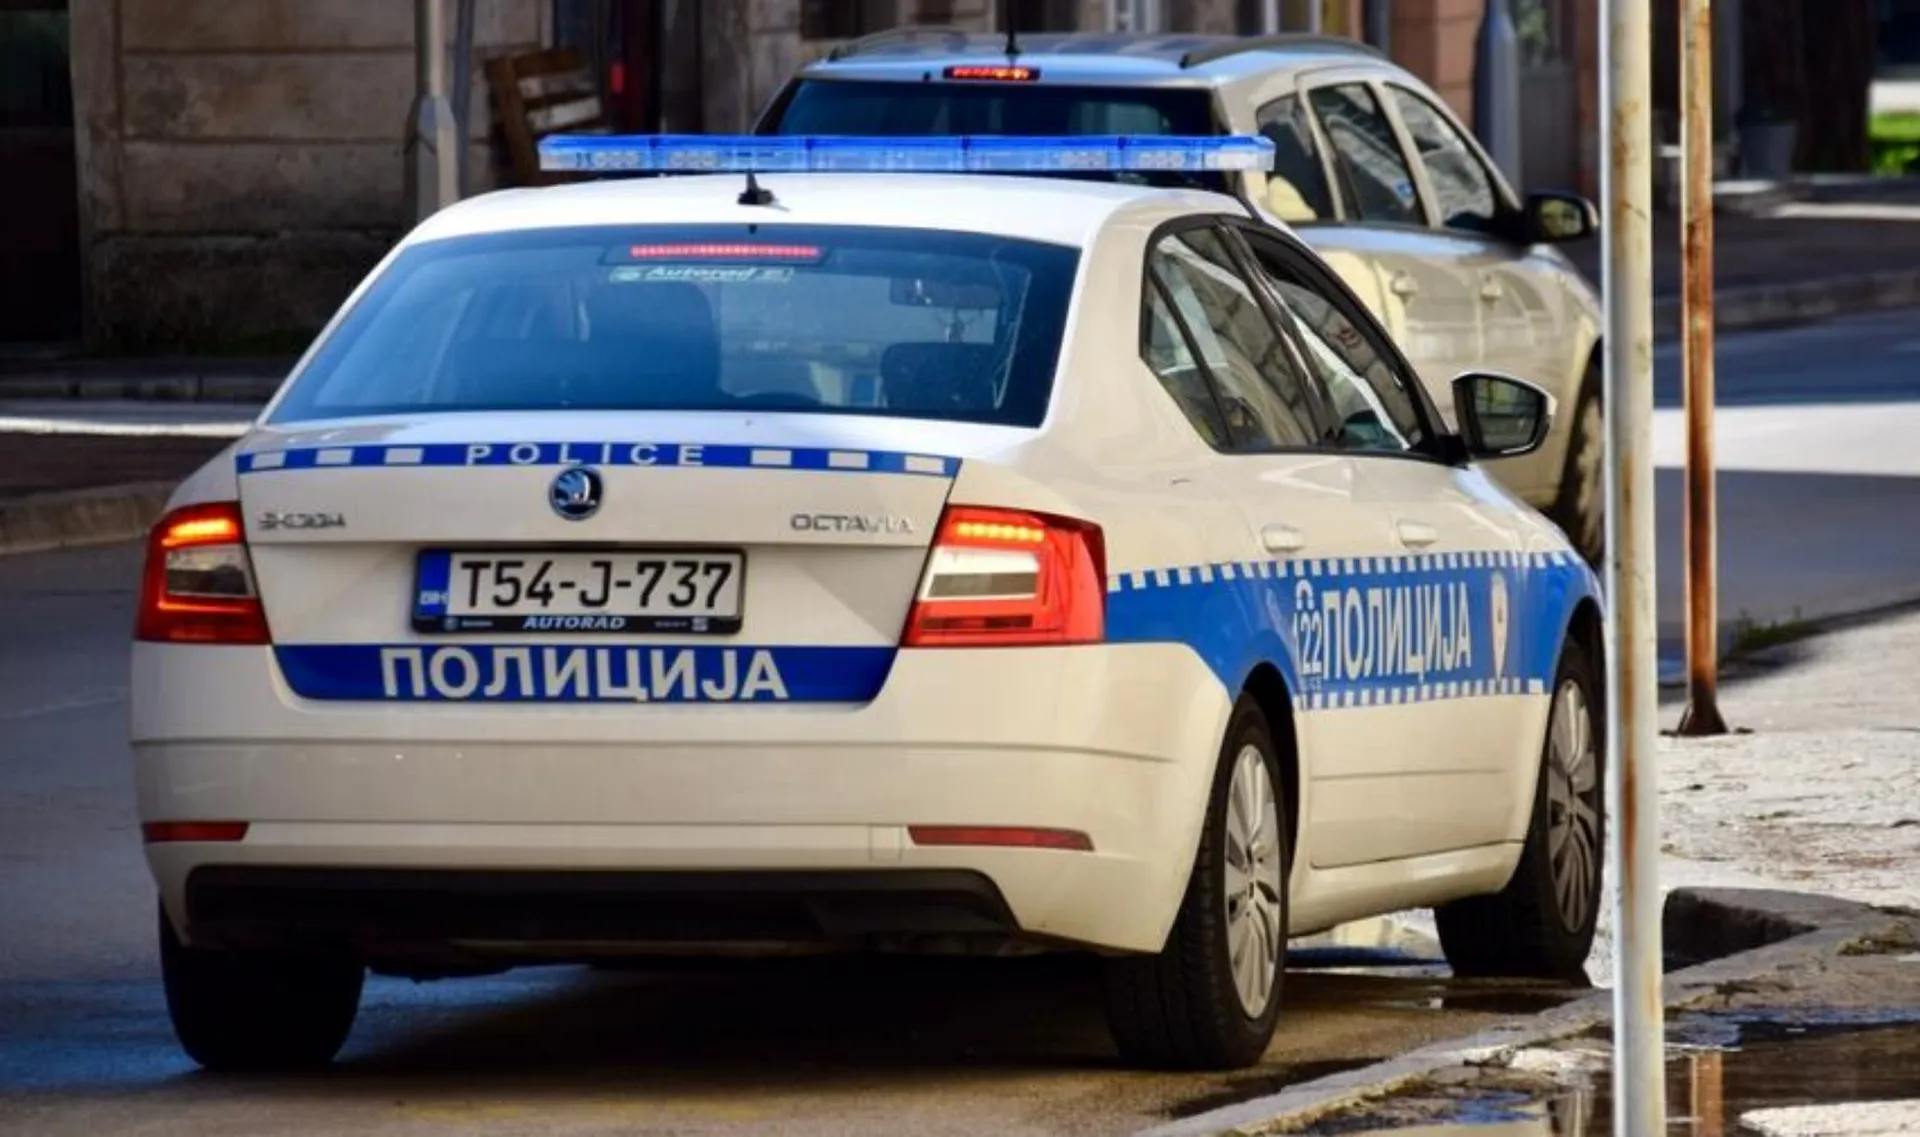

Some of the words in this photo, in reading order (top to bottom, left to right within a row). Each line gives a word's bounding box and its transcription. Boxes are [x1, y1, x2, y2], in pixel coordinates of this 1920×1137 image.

[466, 442, 704, 466] POLICE
[790, 513, 915, 533] OCTAVIA
[460, 560, 734, 609] T54-J-737
[523, 616, 626, 630] AUTORAD
[1321, 581, 1471, 683] ПОЛИЦИЈА
[380, 647, 790, 702] ПОЛИЦИЈА
